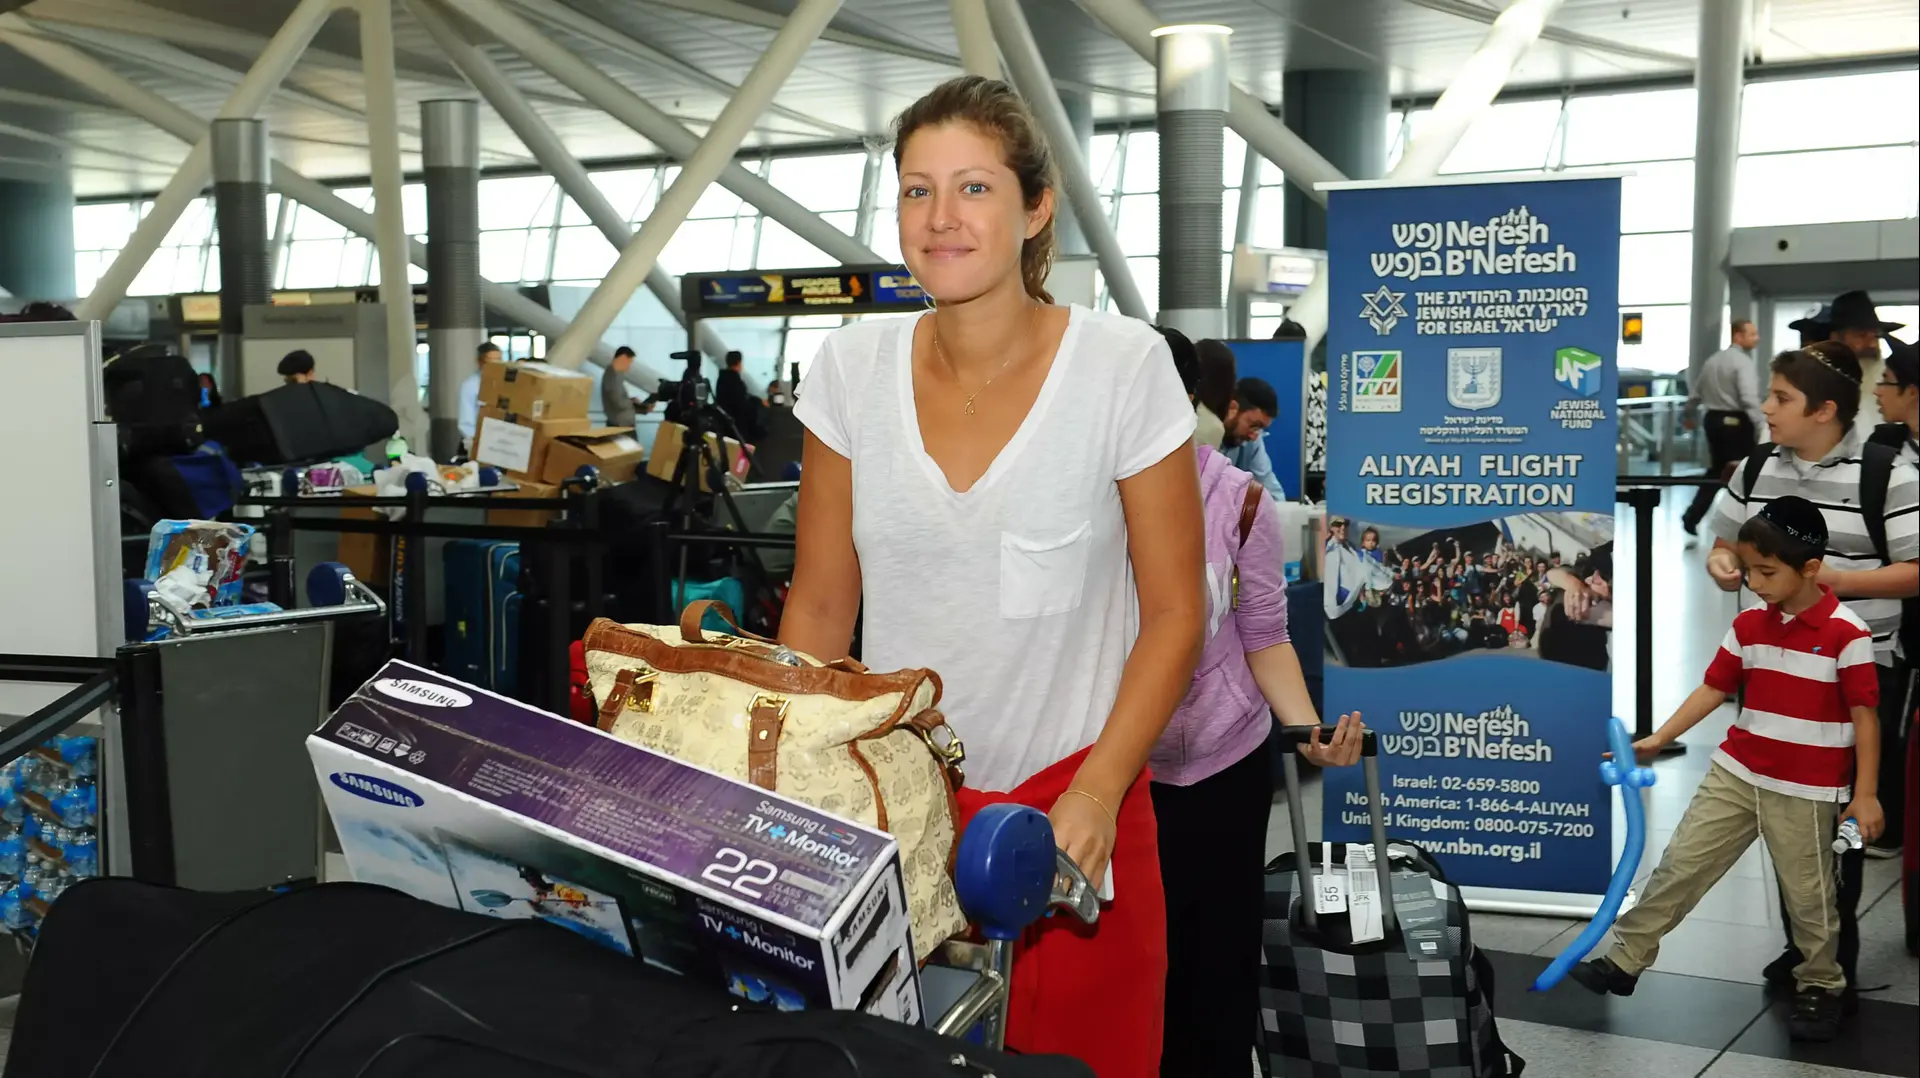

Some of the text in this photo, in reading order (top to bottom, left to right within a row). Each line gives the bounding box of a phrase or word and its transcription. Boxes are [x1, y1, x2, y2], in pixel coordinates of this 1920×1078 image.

[1392, 222, 1443, 251] נפש
[1446, 216, 1549, 250] Nefesh
[1370, 251, 1443, 281] בנפש
[1446, 244, 1576, 276] B'Nefesh
[1415, 292, 1444, 305] THE
[1447, 287, 1588, 305] הסוכנות היהודית
[1415, 304, 1535, 321] JEWISH AGENCY
[1539, 302, 1588, 319] לארץ
[1417, 319, 1500, 335] FOR ISRAEL
[1500, 318, 1558, 333] ישראל
[1550, 410, 1606, 420] NATIONAL
[1555, 400, 1599, 410] JEWISH
[1444, 415, 1475, 425] ישראל
[1562, 420, 1593, 429] FUND
[1359, 454, 1582, 476] ALIYAH FLIGHT
[1366, 484, 1573, 505] REGISTRATION
[390, 679, 457, 707] SAMSUNG
[1400, 711, 1441, 737] נפש
[1444, 712, 1529, 738] Nefesh
[1382, 734, 1442, 759] בנפש
[1444, 736, 1552, 762] B'Nefesh
[337, 772, 416, 807] SAMSUNG
[1393, 774, 1541, 795] Israel: 02-659-5800
[756, 800, 819, 833] Samsung
[1346, 792, 1589, 817] Noh America: 1-866-4-ALIYAH
[1342, 811, 1594, 837] Unitd Kingdom: 0800-075-7200
[1405, 837, 1541, 863] ww.nbn.org.il
[701, 847, 778, 900] 22
[1324, 886, 1339, 902] 55
